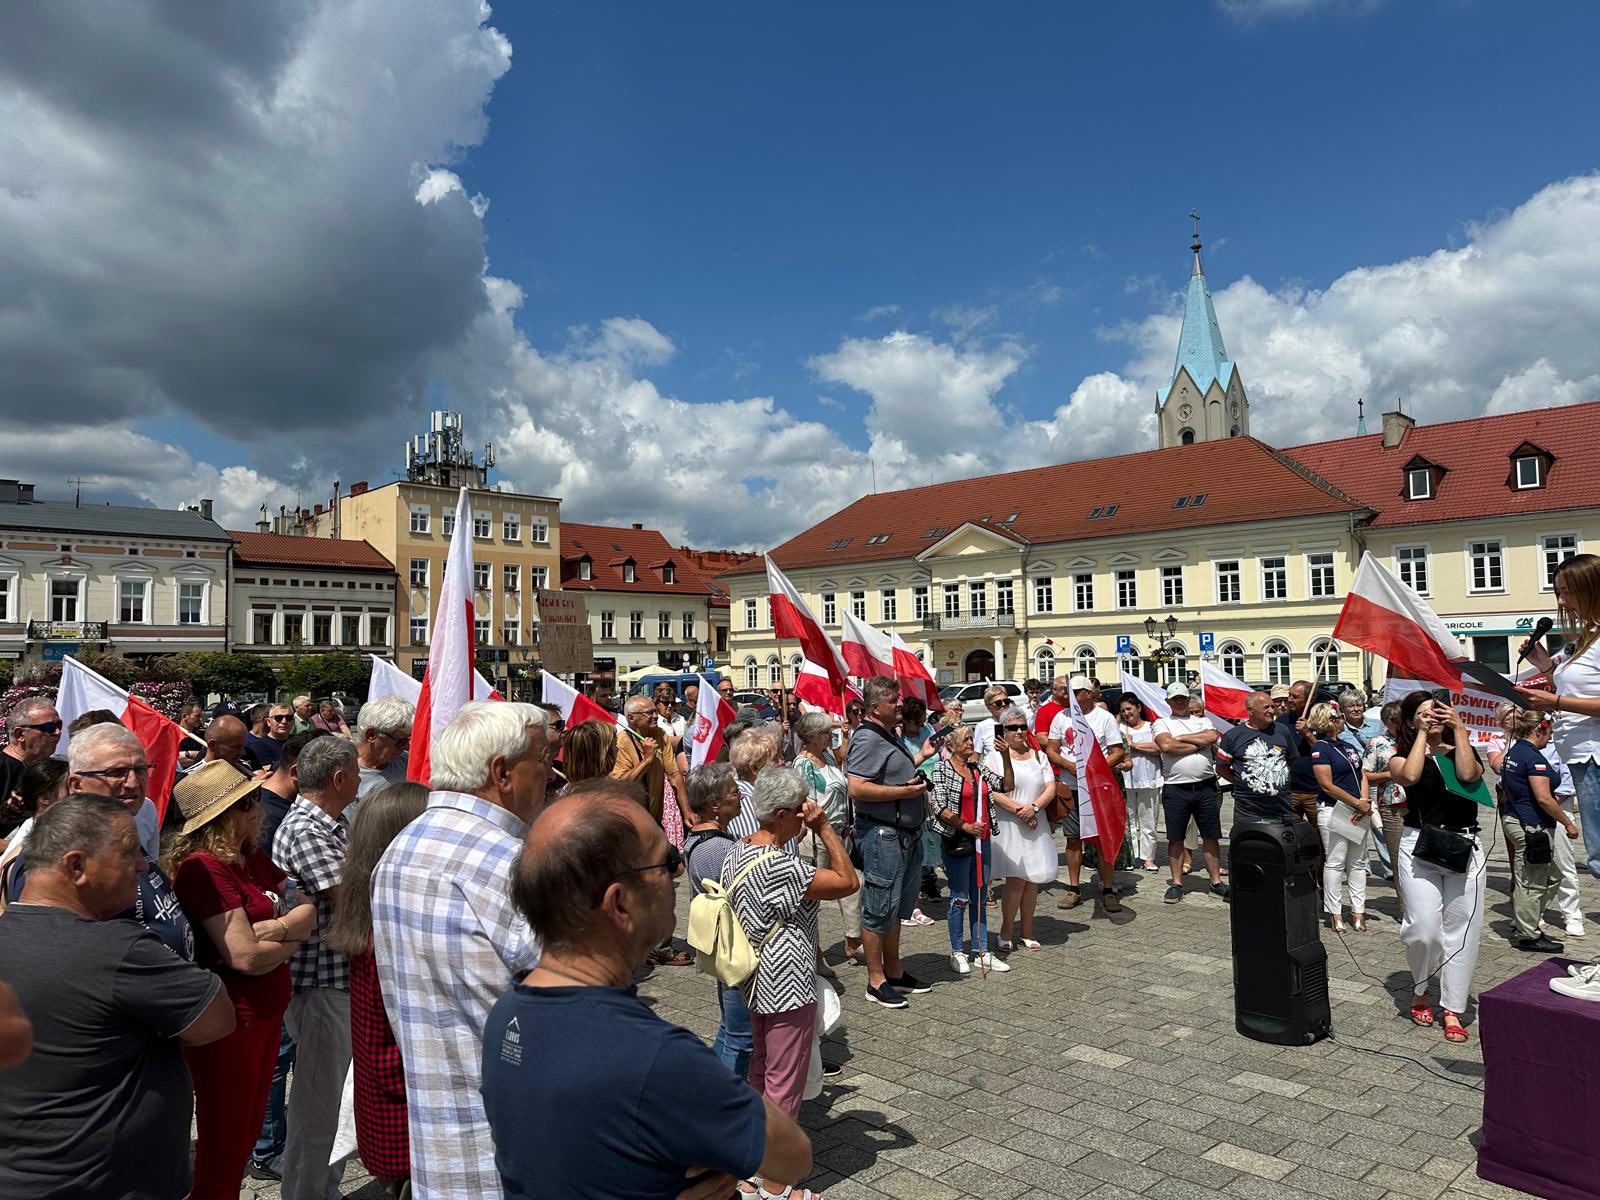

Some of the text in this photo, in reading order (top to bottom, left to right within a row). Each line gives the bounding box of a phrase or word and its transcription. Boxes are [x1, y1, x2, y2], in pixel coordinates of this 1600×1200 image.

[1120, 637, 1128, 648] P
[1203, 634, 1211, 645] P
[707, 659, 713, 667] P
